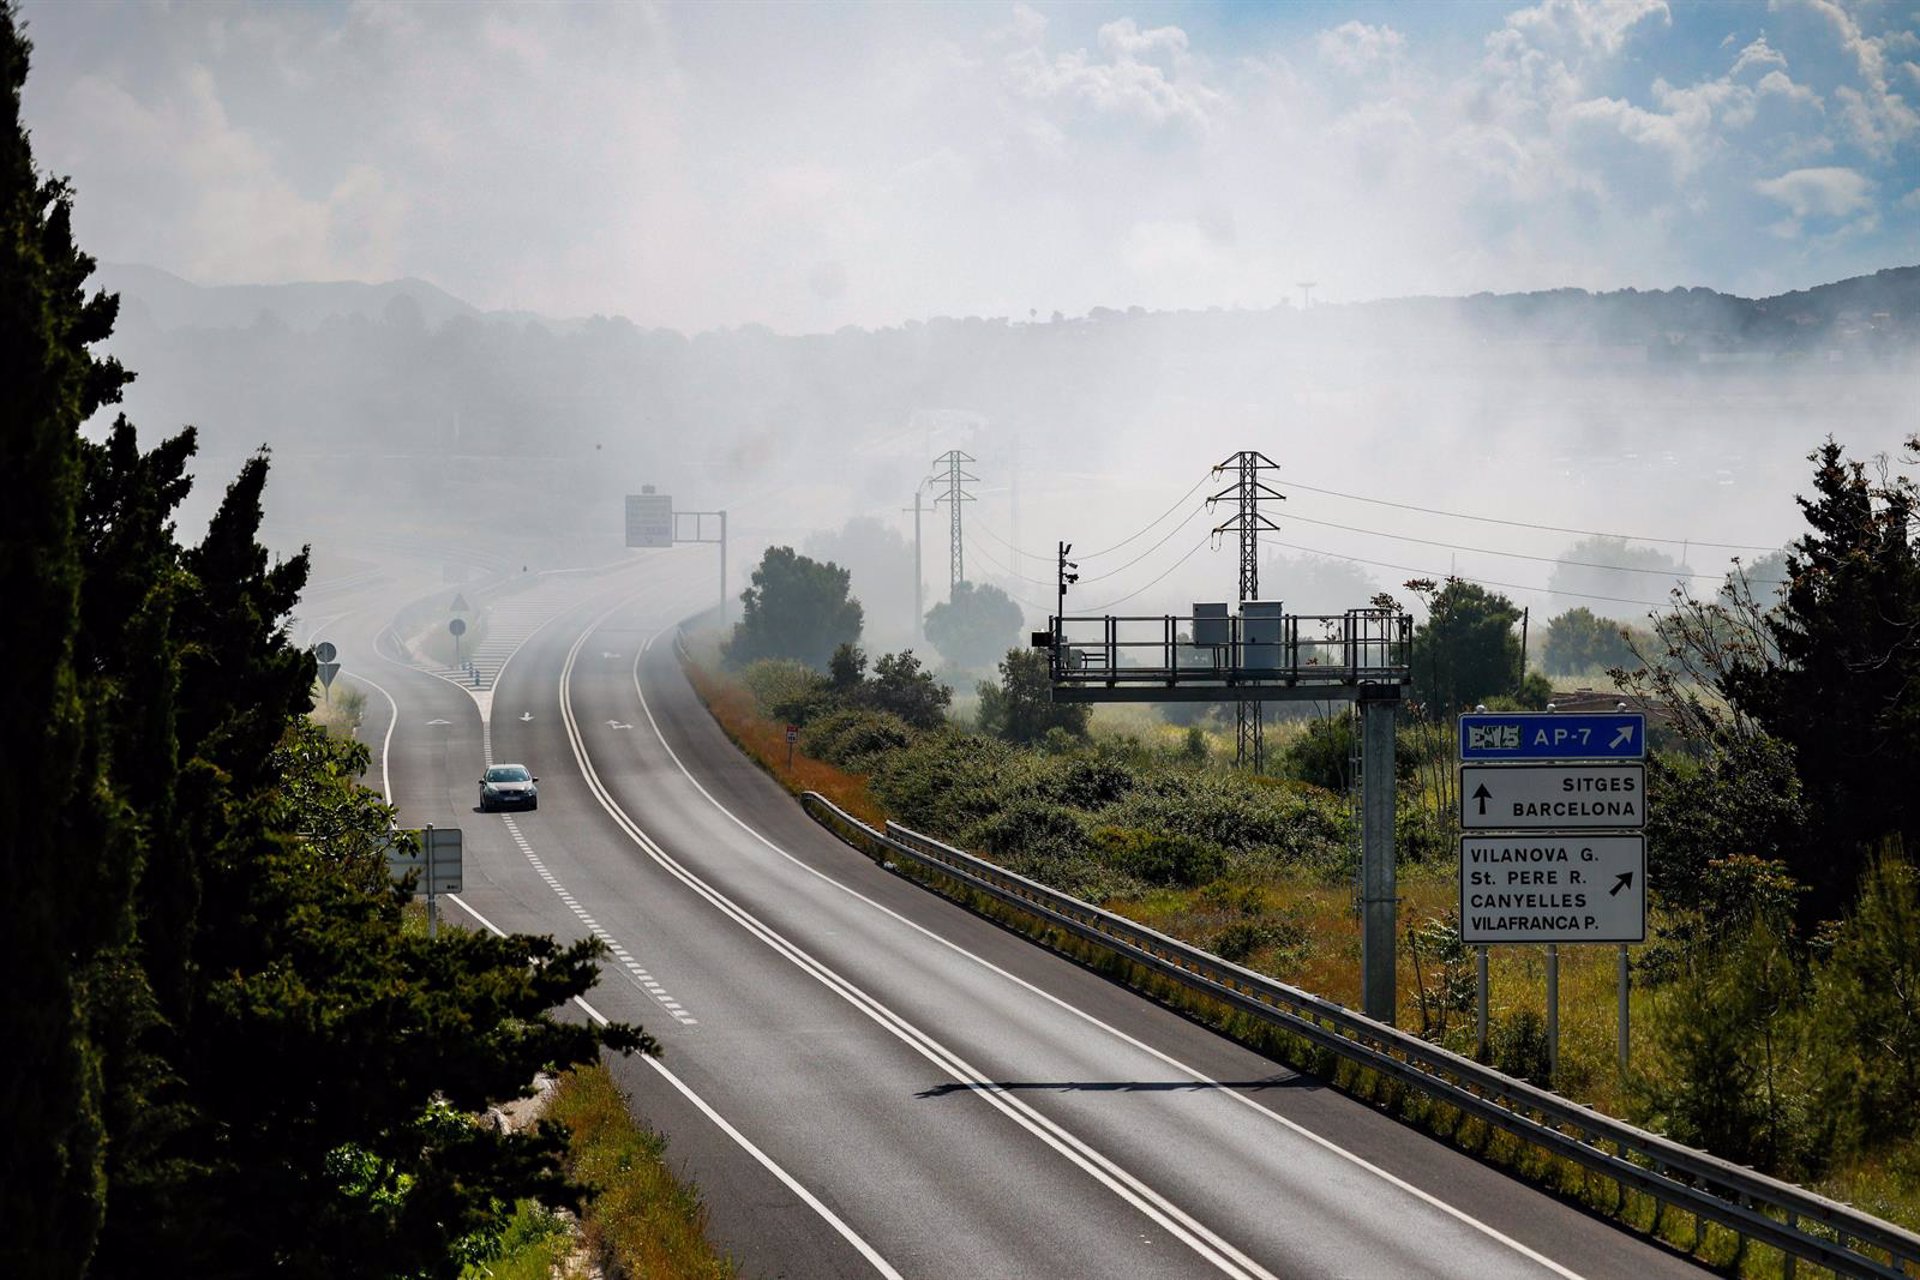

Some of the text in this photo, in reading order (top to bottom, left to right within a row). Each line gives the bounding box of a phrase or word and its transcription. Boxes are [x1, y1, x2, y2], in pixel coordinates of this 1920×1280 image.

[1533, 728, 1592, 746] AP-7
[1563, 777, 1635, 792] SITGES
[1513, 802, 1635, 817] BARCELONA
[1471, 848, 1598, 863] VILANOVA G.
[1471, 870, 1586, 885] St. PERE R.
[1471, 894, 1587, 908] CANYELLES
[1472, 916, 1599, 931] VILAFRANCA P.
